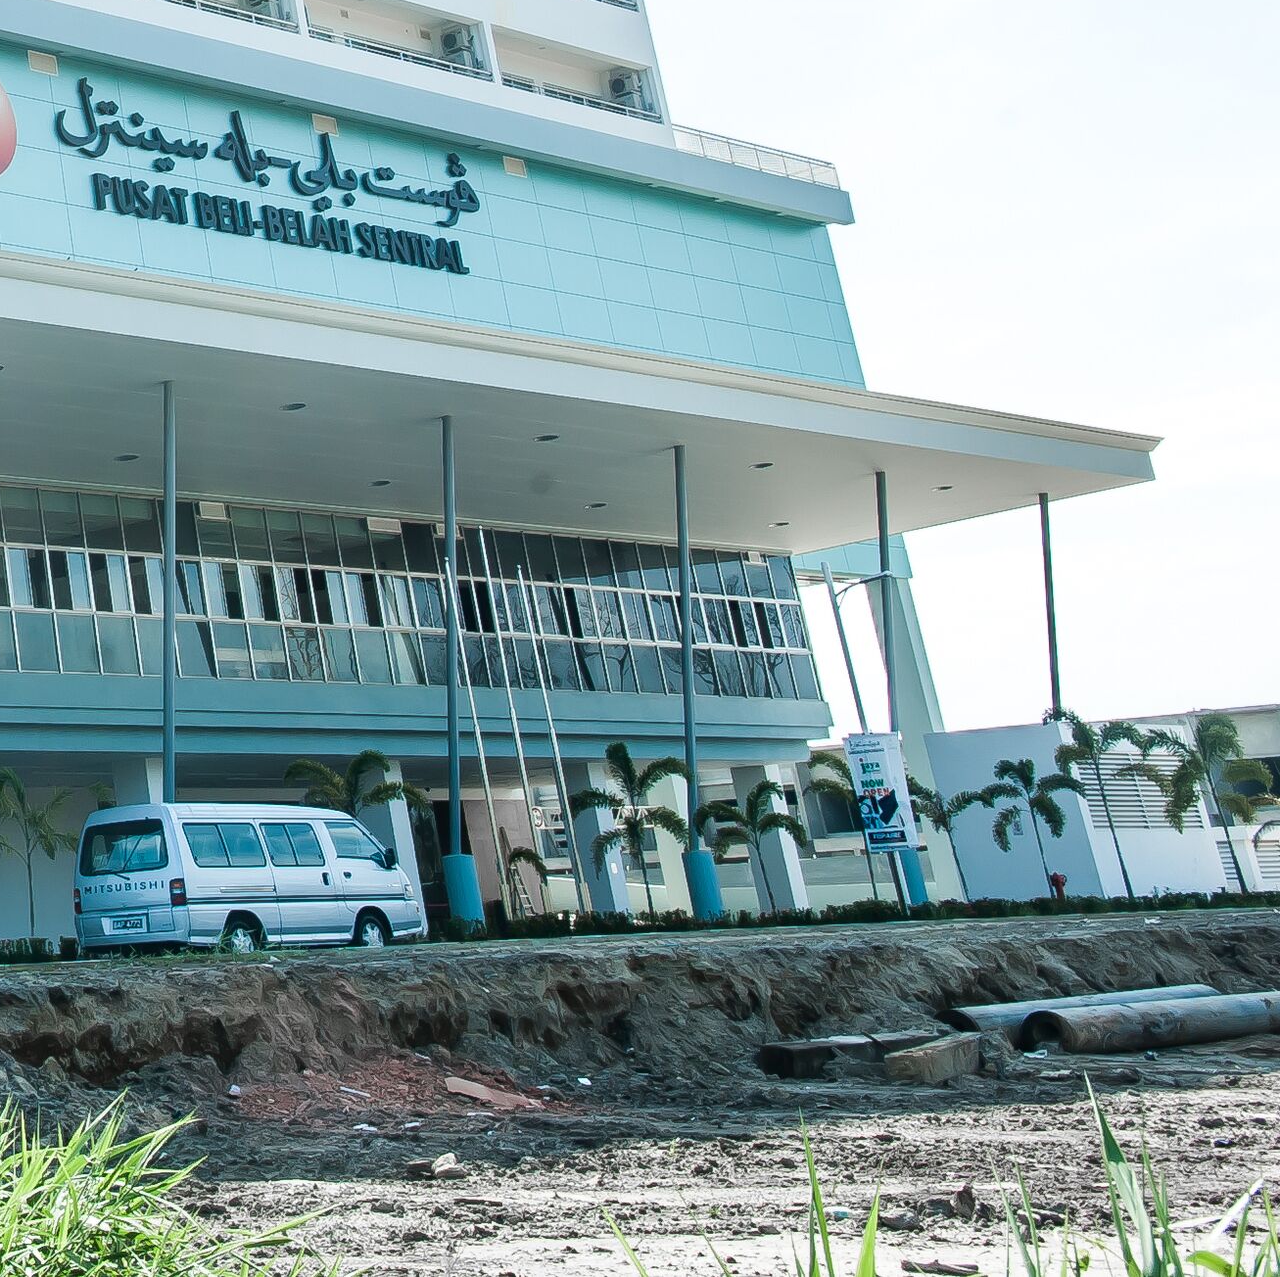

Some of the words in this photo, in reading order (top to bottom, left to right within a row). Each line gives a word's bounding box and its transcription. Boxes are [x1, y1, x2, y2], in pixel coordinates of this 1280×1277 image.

[91, 172, 188, 224] PUSAT
[192, 191, 354, 254] BELI-BELAH
[354, 222, 470, 274] SENTRAL
[861, 779, 884, 789] NOW
[863, 787, 891, 798] OPEN
[84, 880, 164, 895] MITSUBISHI
